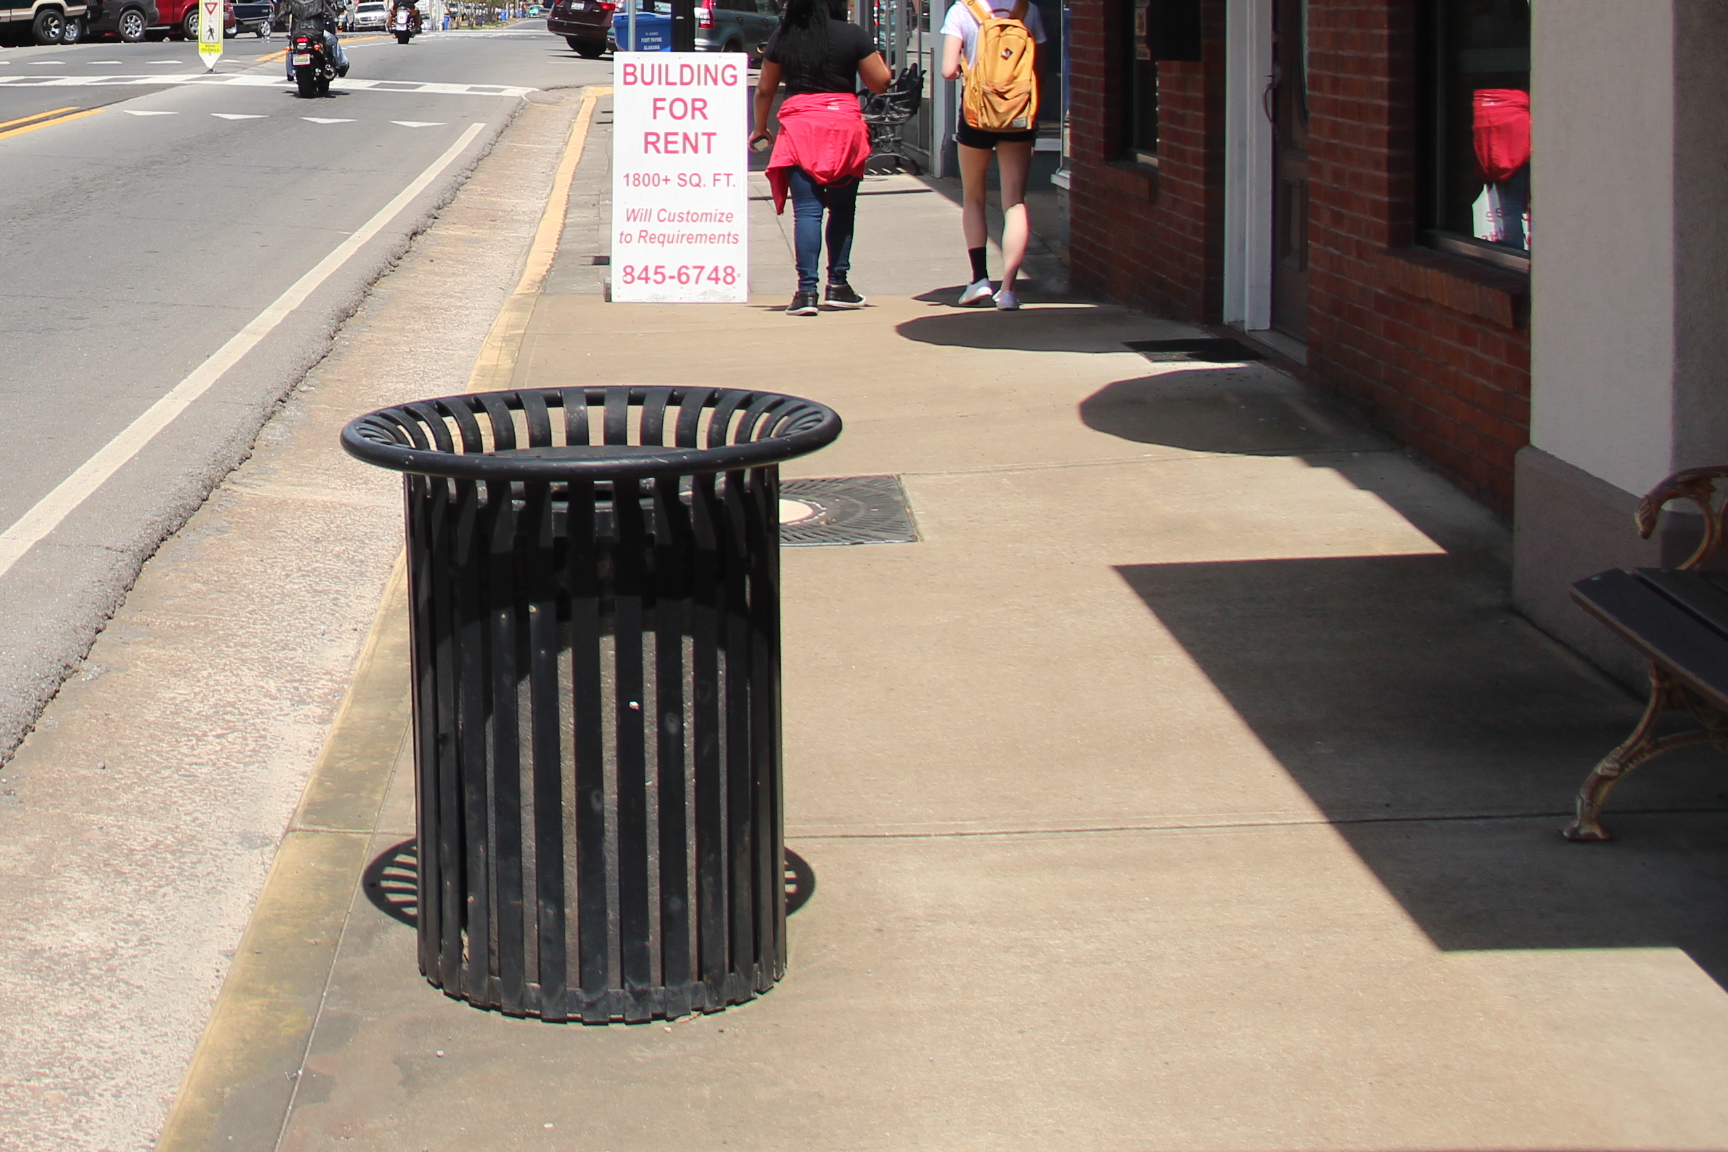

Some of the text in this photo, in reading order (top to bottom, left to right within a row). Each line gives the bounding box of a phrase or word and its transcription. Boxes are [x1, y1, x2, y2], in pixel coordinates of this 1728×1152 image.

[623, 63, 737, 86] BUILDING
[652, 97, 708, 120] FOR
[644, 132, 717, 154] RENT
[623, 173, 735, 188] 1800+ SQ. FT.
[626, 208, 734, 222] Will Customize
[619, 230, 739, 247] to Requirements
[622, 265, 736, 285] 845-6748
